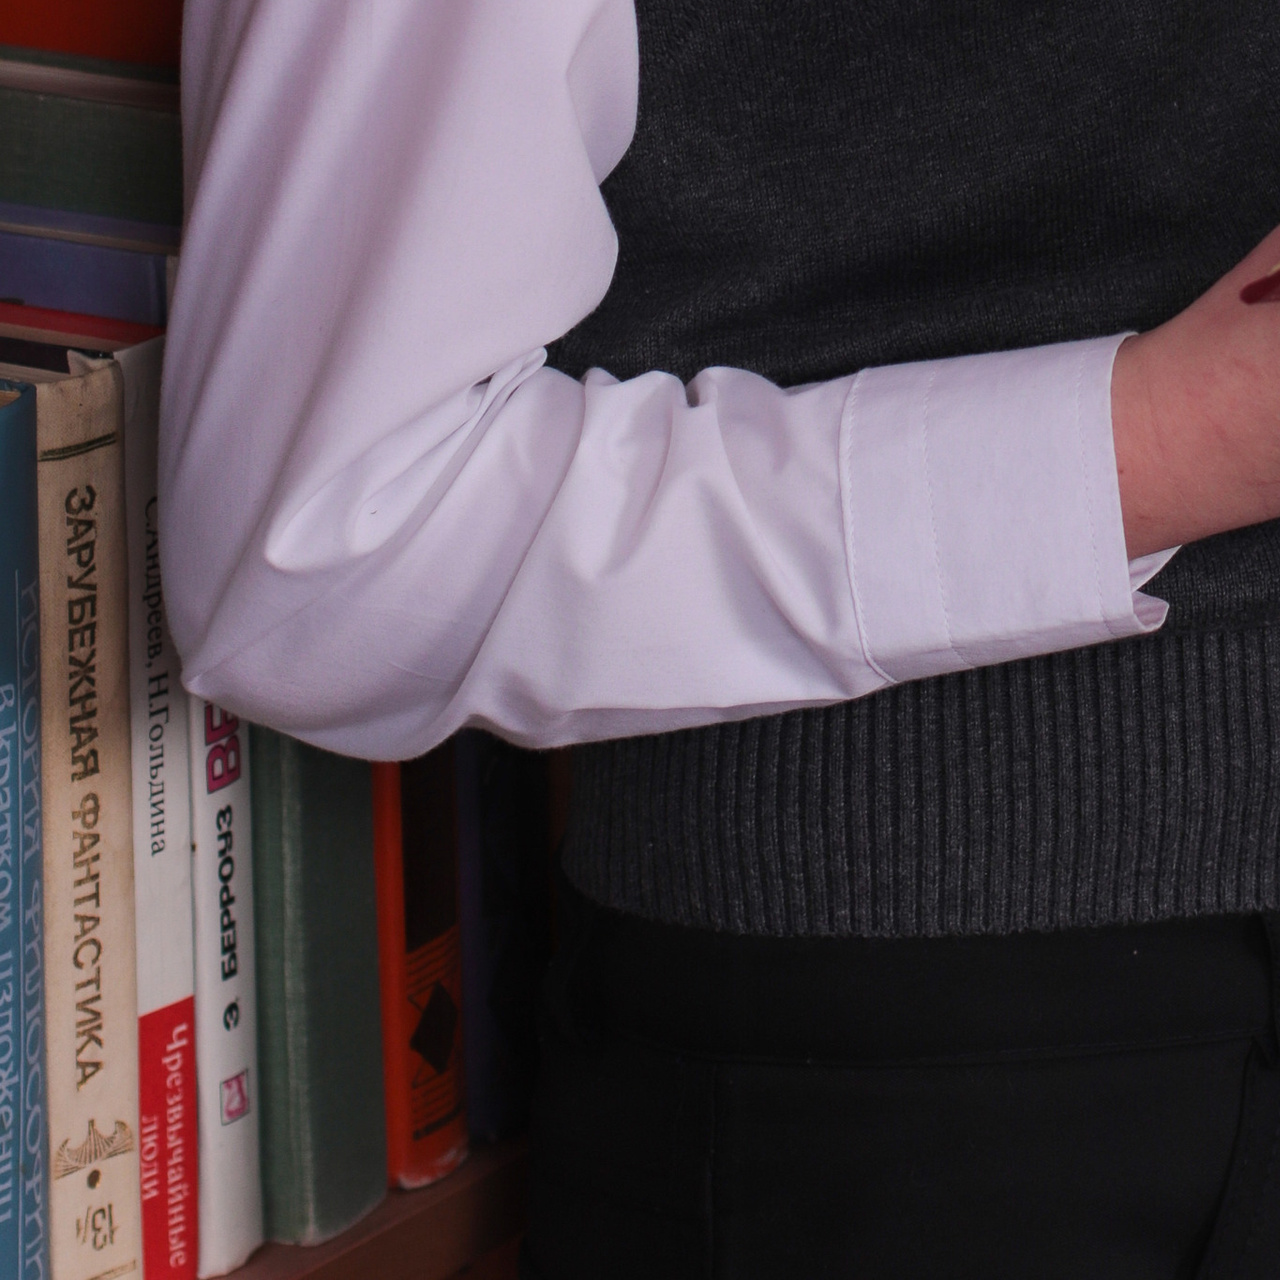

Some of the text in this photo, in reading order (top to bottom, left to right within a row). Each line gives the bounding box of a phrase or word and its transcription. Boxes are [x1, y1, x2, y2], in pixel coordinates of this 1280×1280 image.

[64, 483, 105, 1093] ЗАРУБЕЖНАЯ ФАНТАСТИКА
[148, 671, 171, 857] Н.Гольдина
[216, 803, 238, 982] БЕРРОУЗ
[141, 1022, 190, 1269] Чрезвычайные люди
